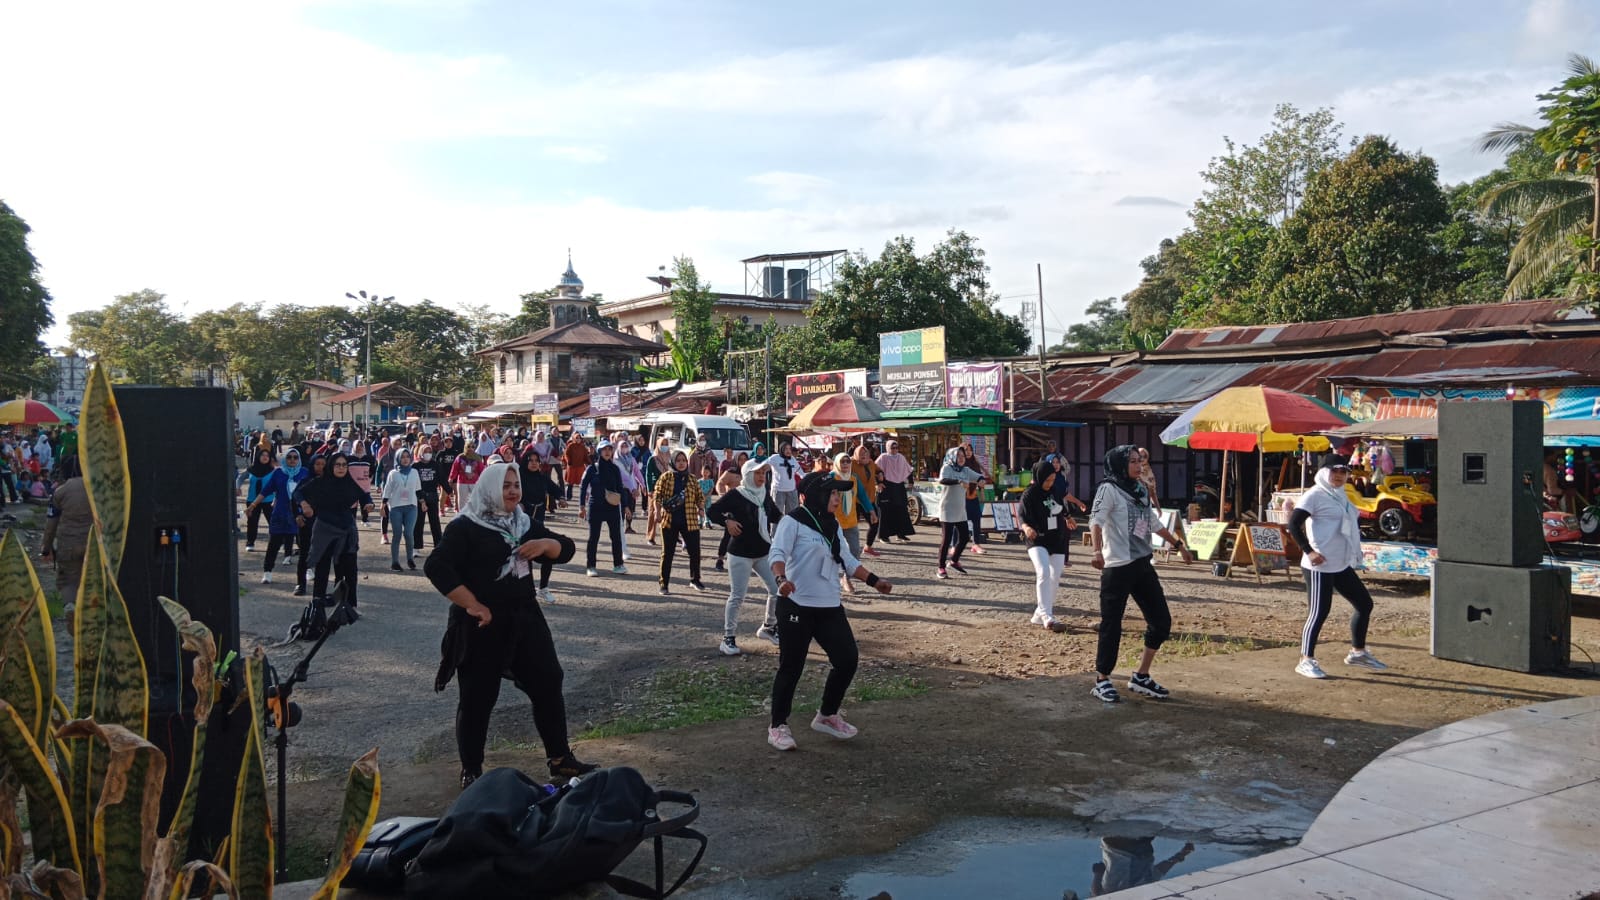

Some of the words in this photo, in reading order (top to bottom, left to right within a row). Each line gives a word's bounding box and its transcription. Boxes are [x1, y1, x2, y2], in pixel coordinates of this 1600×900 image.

[881, 345, 901, 354] vivo
[902, 344, 921, 355] oppo
[886, 371, 911, 381] MUSLIM
[913, 369, 939, 379] PONSEL
